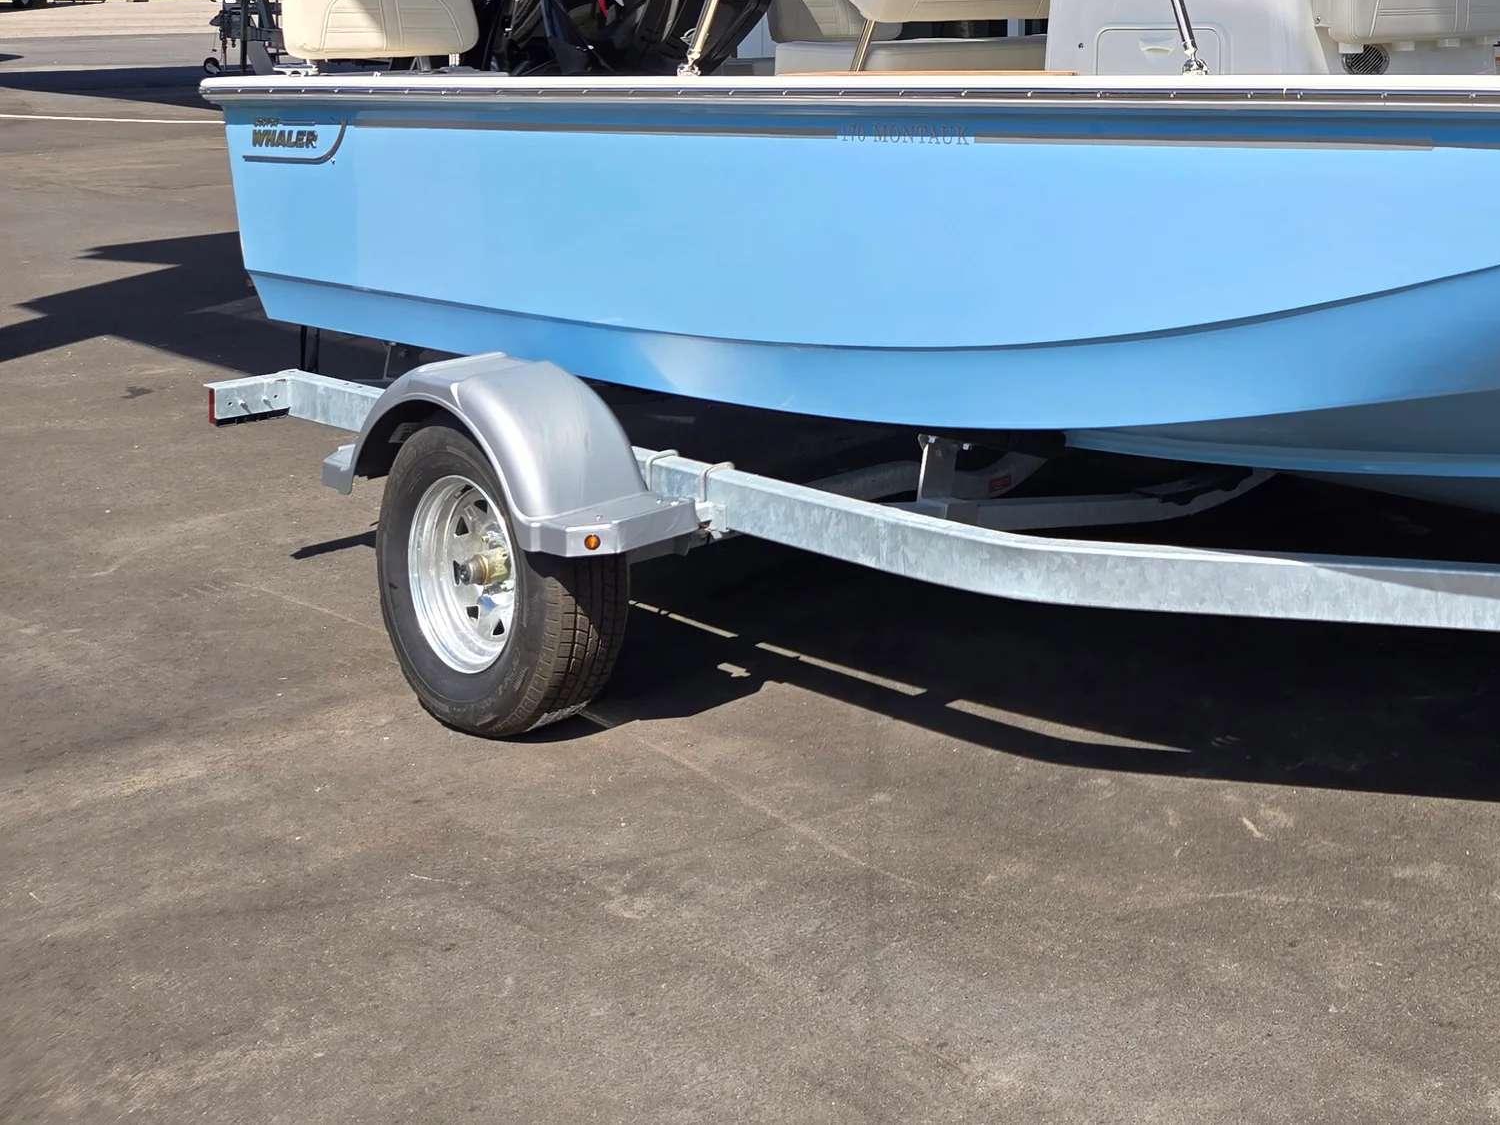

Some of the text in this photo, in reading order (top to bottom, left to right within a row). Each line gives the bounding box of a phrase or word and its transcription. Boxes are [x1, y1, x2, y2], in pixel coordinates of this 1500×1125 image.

[252, 129, 318, 148] WHALER
[841, 124, 970, 145] 170 MONTAUK
